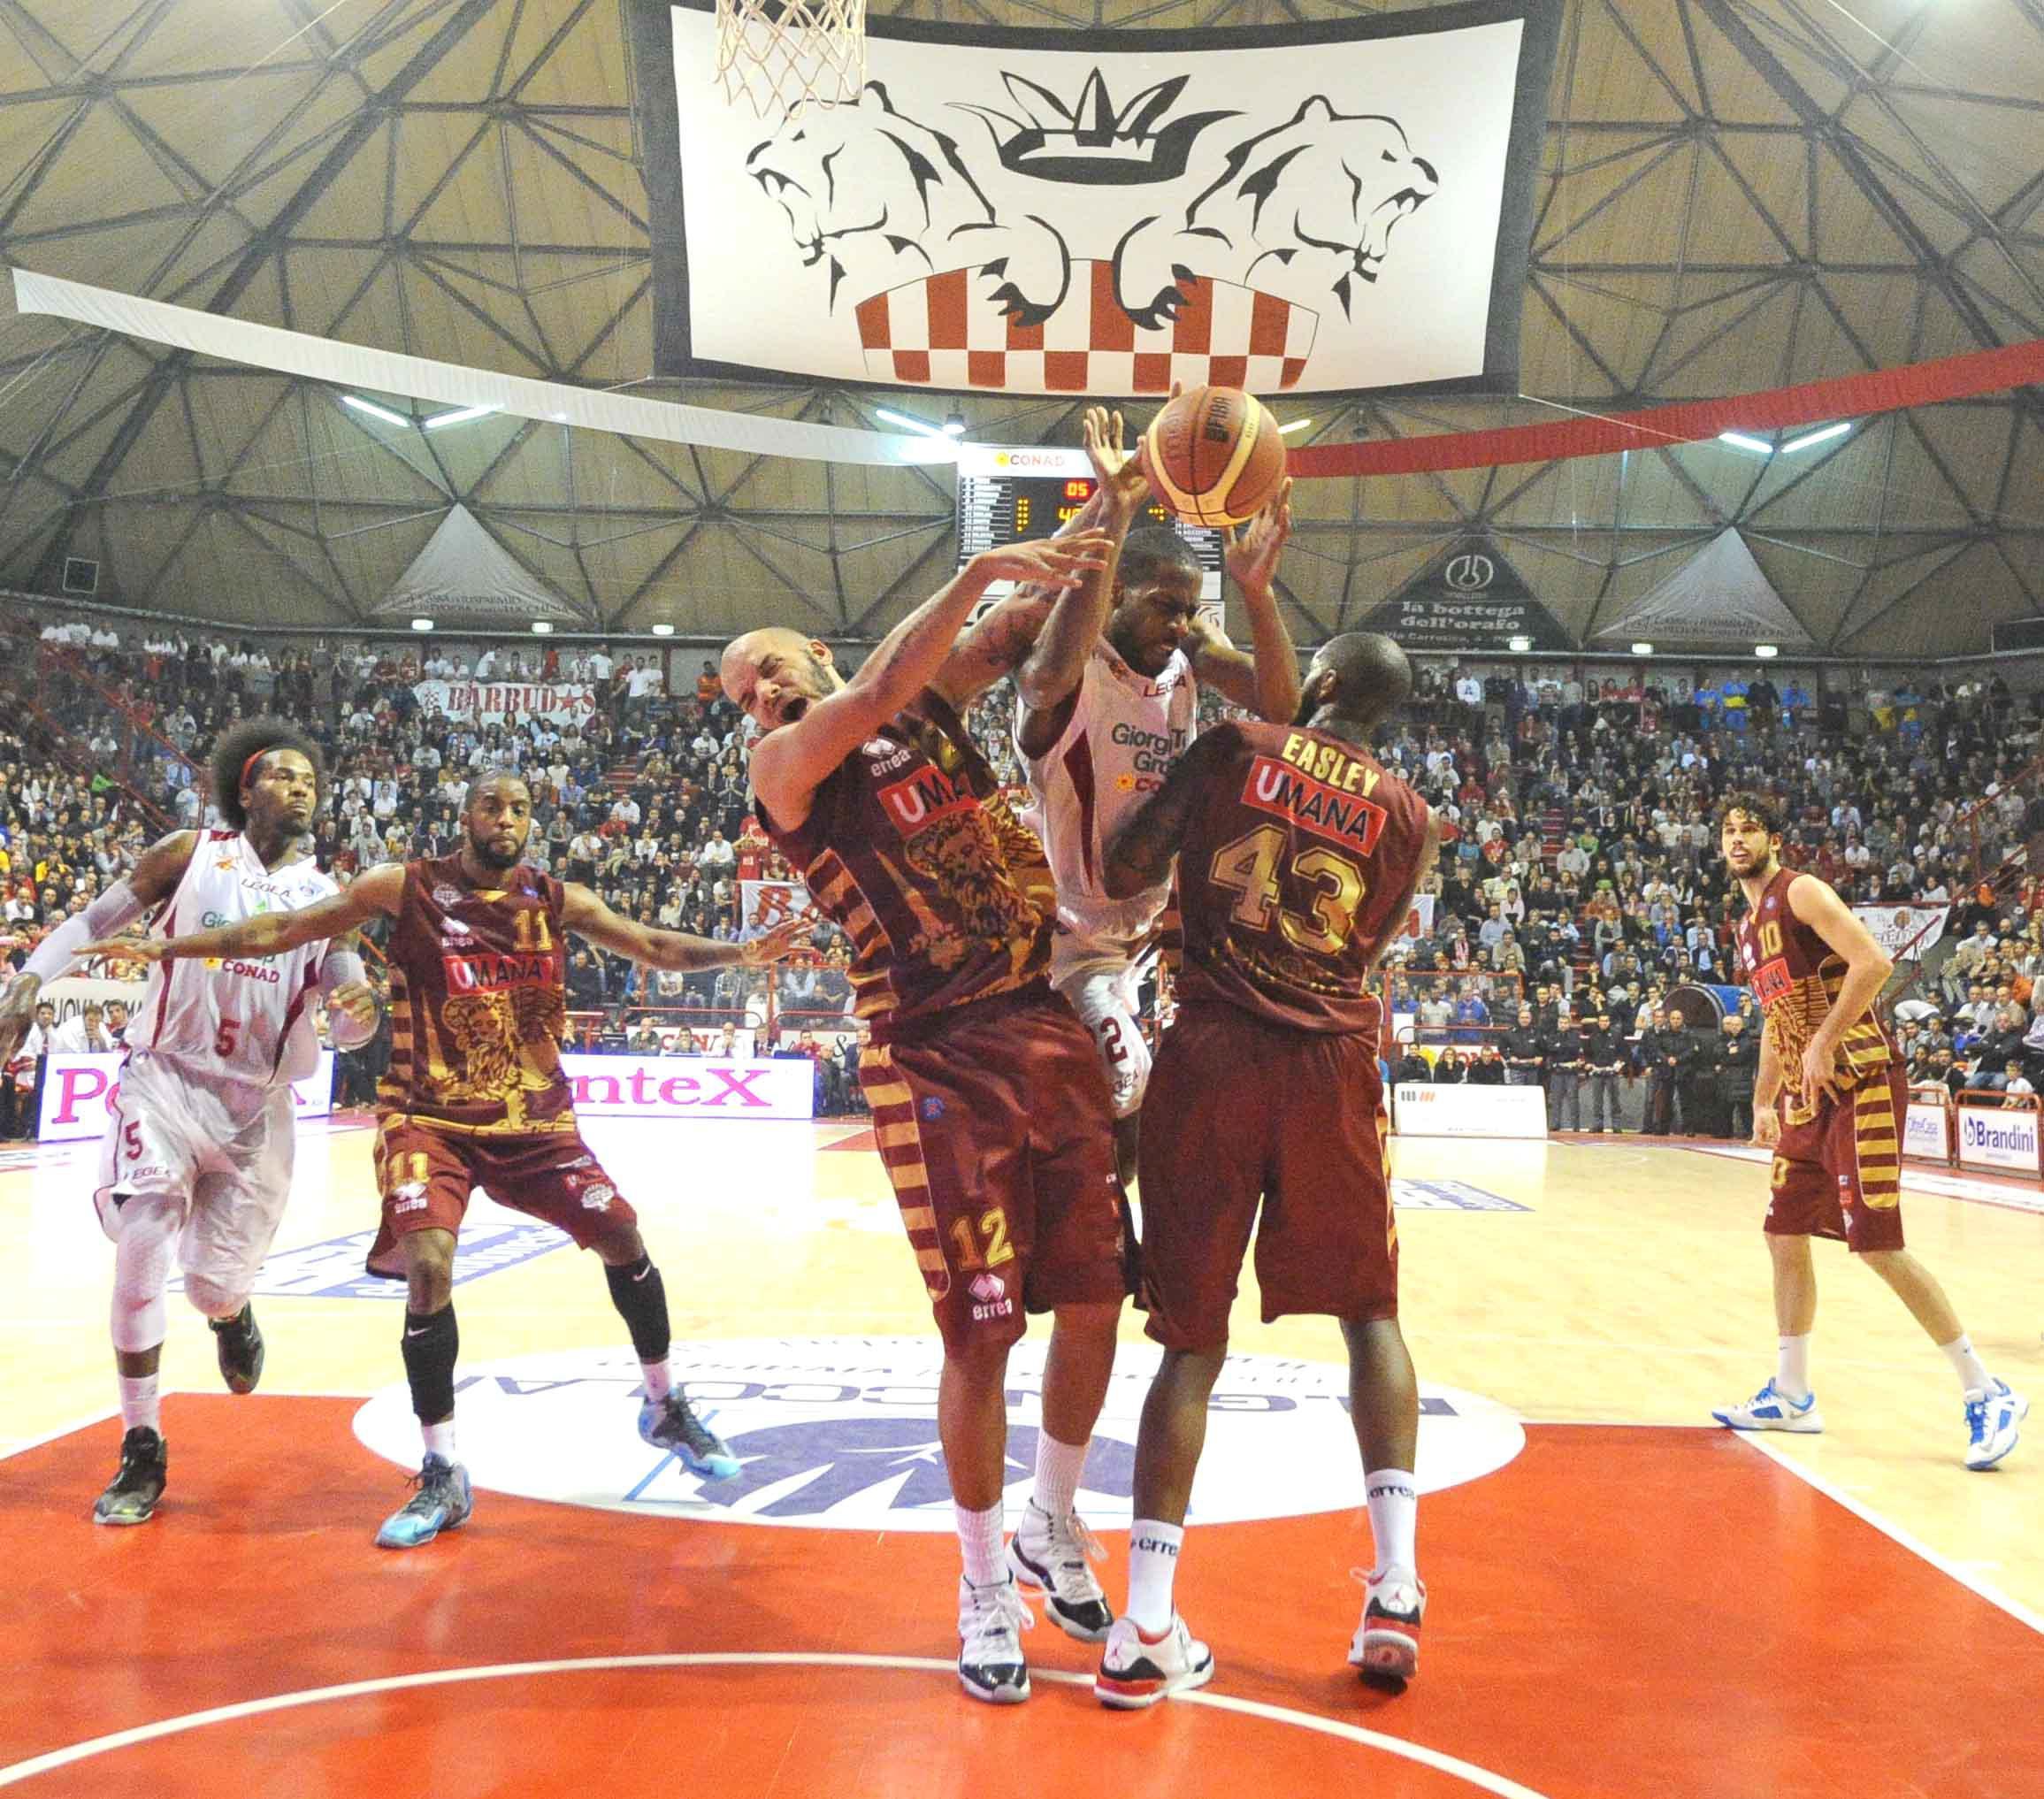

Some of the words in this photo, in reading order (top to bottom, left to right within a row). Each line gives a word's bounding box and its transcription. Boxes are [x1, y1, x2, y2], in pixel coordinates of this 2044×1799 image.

[1010, 455, 1065, 467] CONAD
[1400, 616, 1520, 630] dell'orafo
[1401, 601, 1425, 613] la
[1433, 603, 1526, 618] bottega
[1282, 733, 1380, 798] EASLEY
[1257, 764, 1370, 843] UMANA
[1208, 823, 1366, 957] 43
[513, 908, 553, 951] 11
[1757, 920, 1783, 961] 10
[222, 960, 280, 984] CONAD
[451, 957, 543, 990] UMANA
[215, 1018, 241, 1057] 5
[1099, 1016, 1129, 1062] 2
[125, 1120, 143, 1160] 5
[1977, 1121, 2034, 1153] Brandini
[389, 1151, 432, 1187] 11
[949, 1206, 1015, 1273] 12
